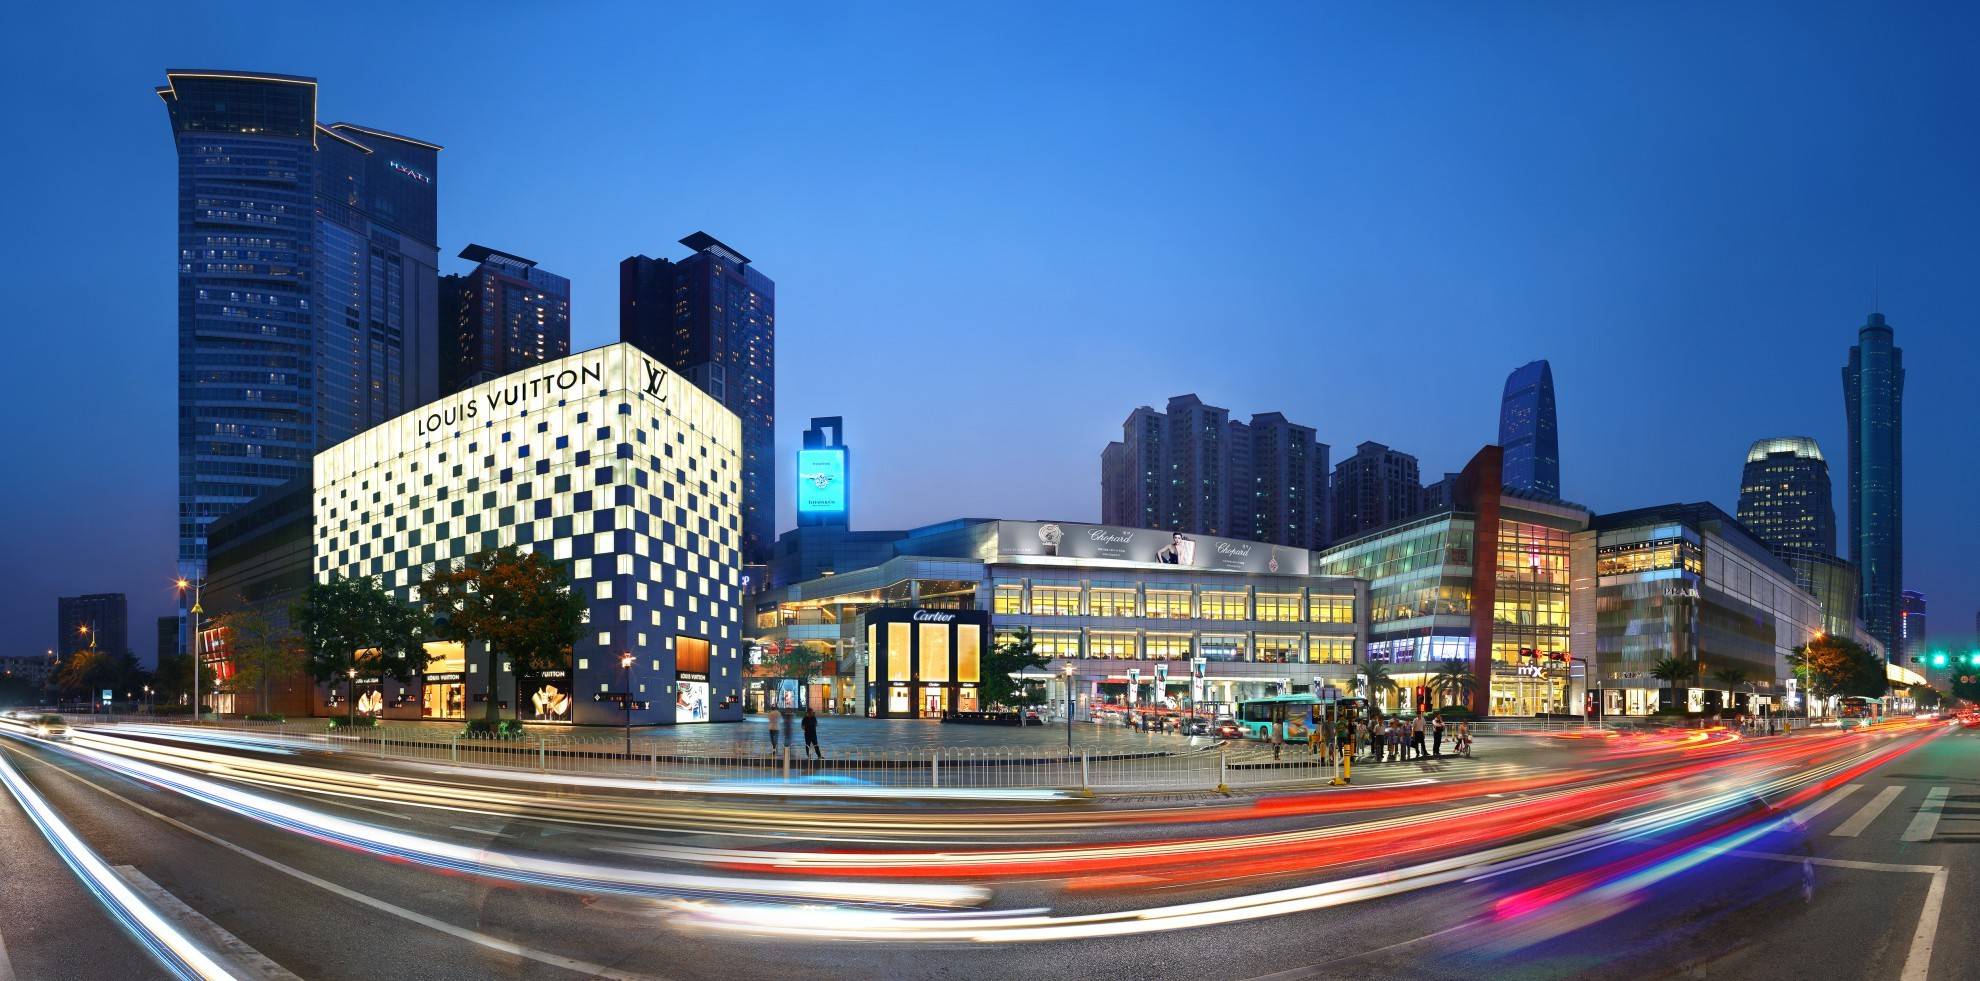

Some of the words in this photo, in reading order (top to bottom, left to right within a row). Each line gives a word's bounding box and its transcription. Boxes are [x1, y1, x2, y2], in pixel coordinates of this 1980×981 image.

[390, 160, 431, 183] HYATT
[418, 399, 477, 436] LOUIS
[487, 362, 600, 410] VUITTON
[1087, 528, 1134, 544] Chopard
[1216, 542, 1252, 557] Chopard
[913, 609, 956, 622] Cartier
